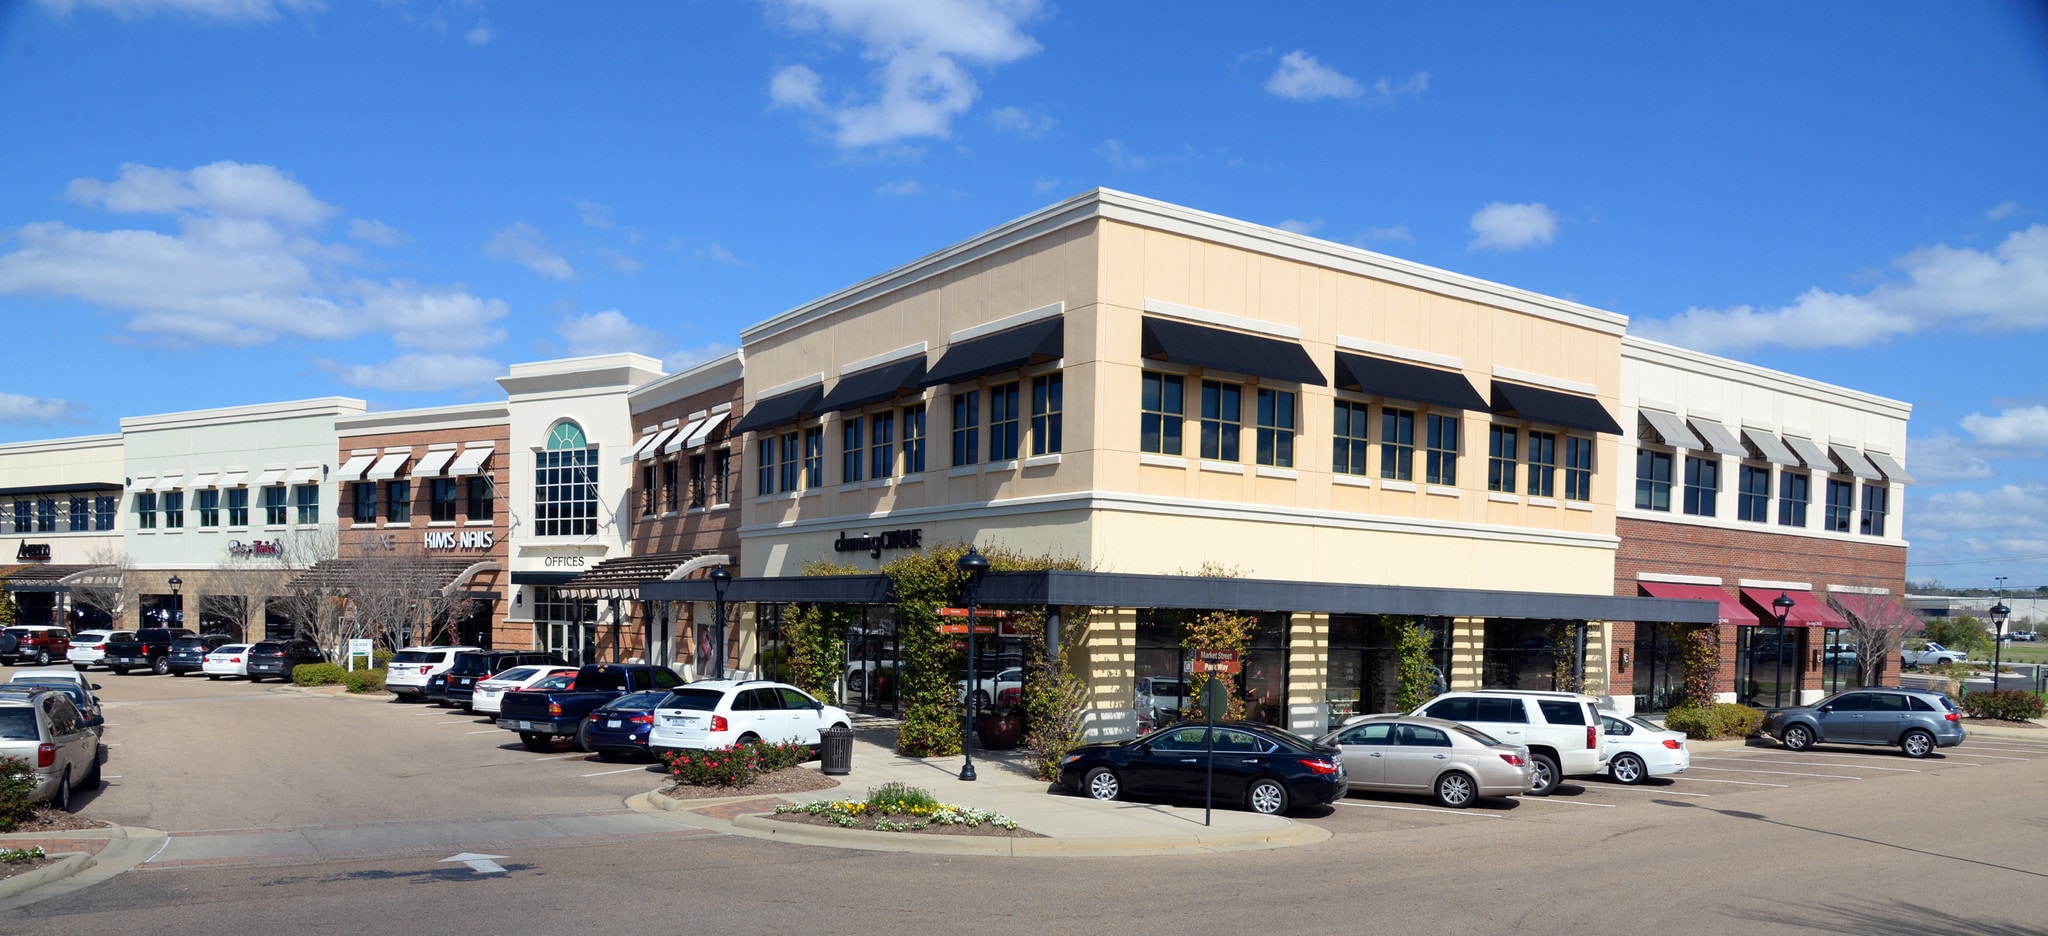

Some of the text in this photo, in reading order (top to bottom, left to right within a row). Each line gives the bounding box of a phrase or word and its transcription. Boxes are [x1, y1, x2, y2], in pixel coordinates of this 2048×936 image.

[424, 531, 494, 549] KIM'S NAILS
[544, 556, 585, 567] OFFICES
[1200, 651, 1233, 661] Market Street
[1217, 663, 1229, 672] Way
